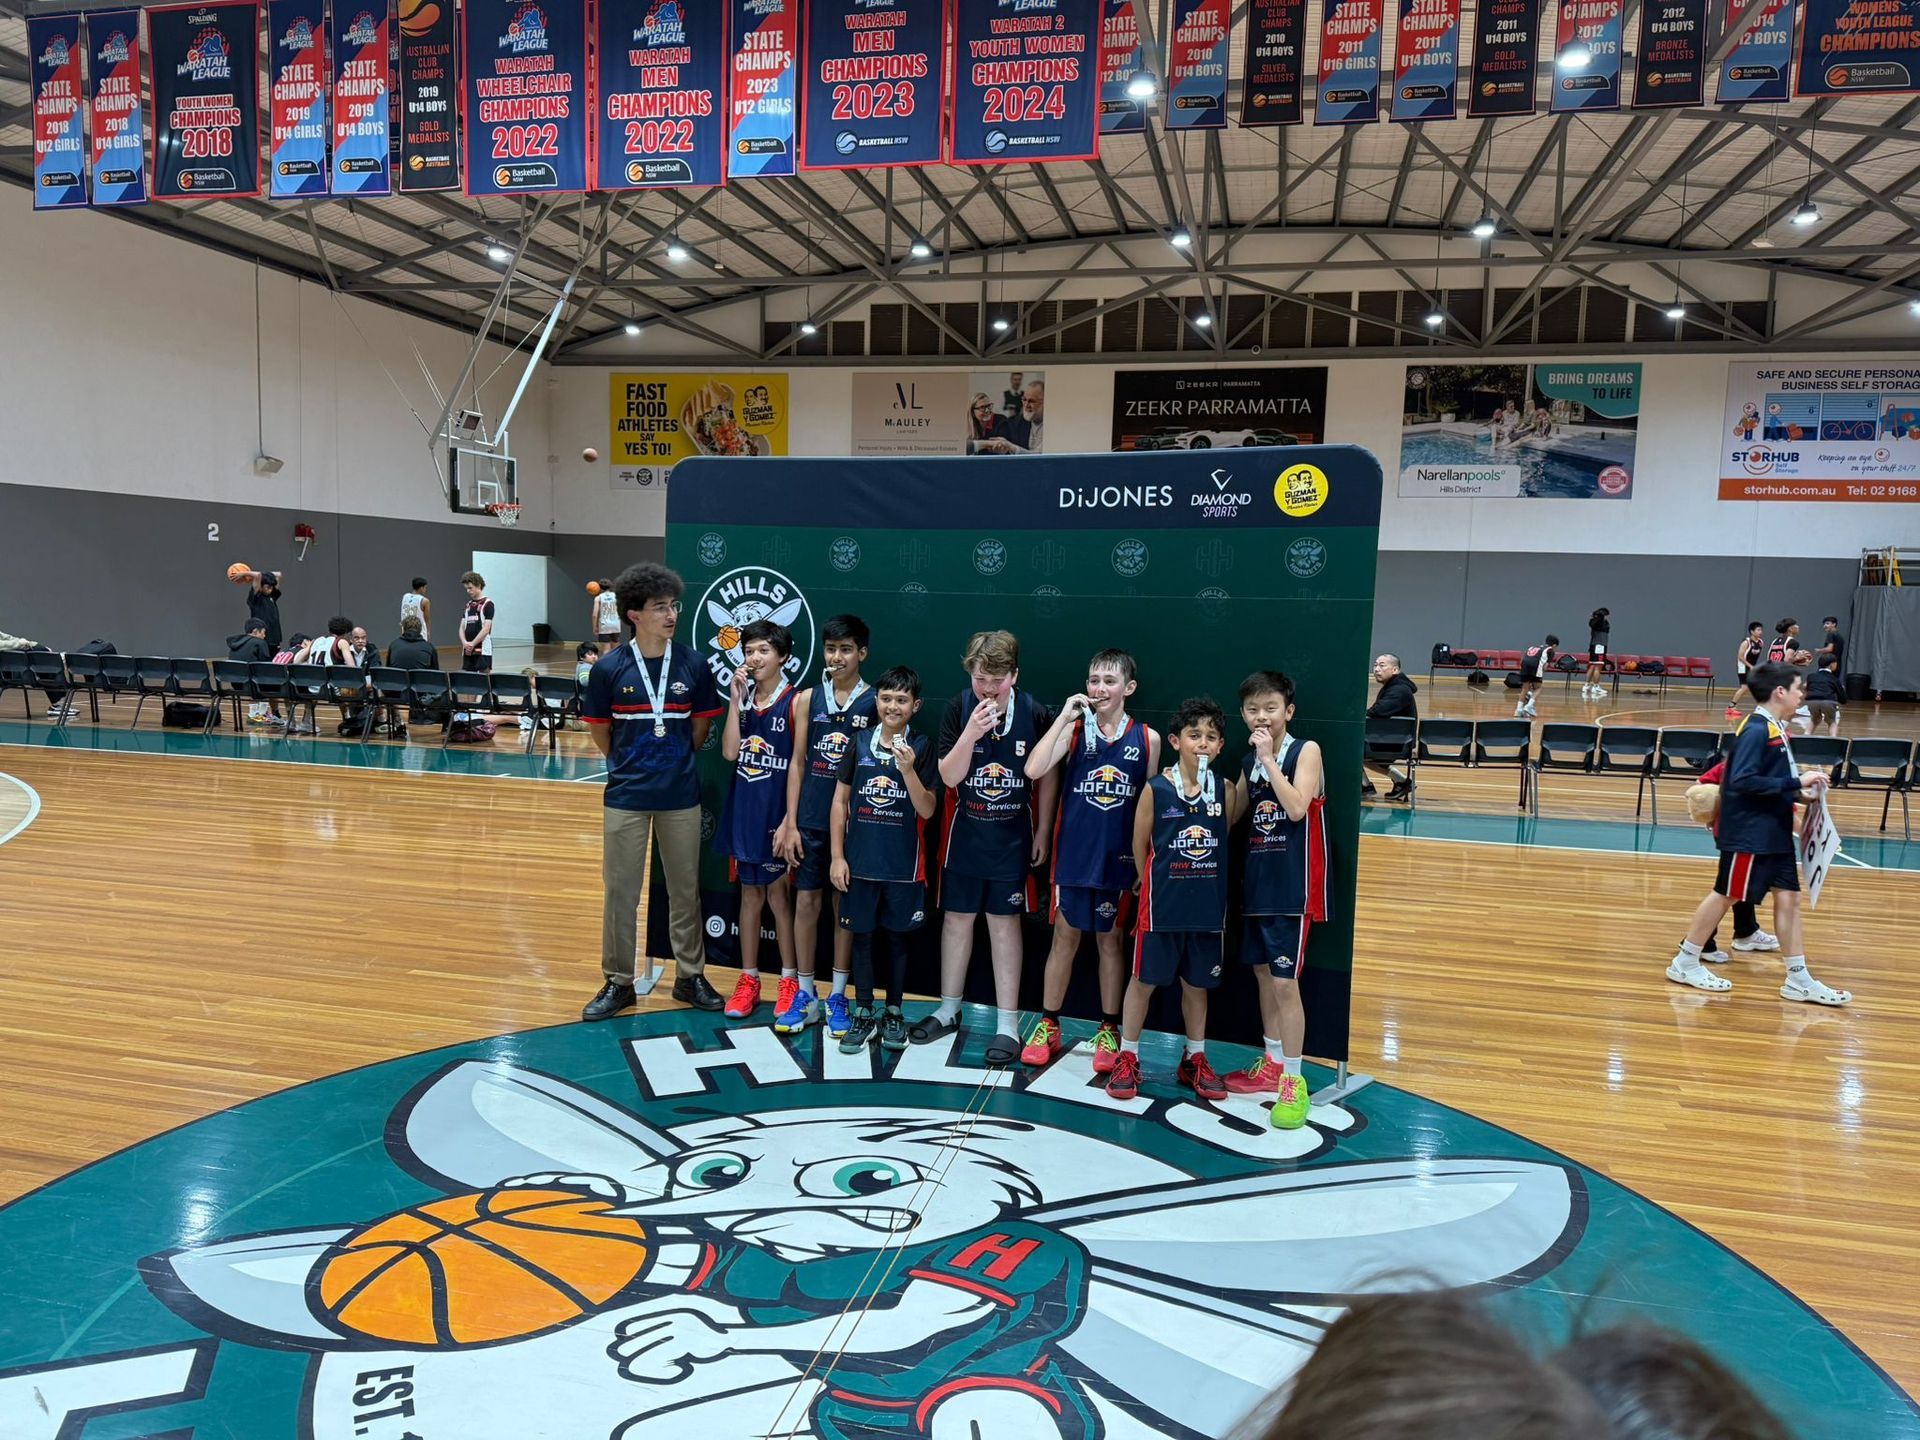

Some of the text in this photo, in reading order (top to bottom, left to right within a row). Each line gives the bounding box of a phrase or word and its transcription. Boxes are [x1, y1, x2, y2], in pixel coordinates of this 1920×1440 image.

[1335, 1, 1370, 19] STATE
[1563, 1, 1618, 20] CHAMPS
[1662, 7, 1685, 19] 2012
[188, 14, 217, 24] SPALDING
[844, 11, 906, 30] WARATAH
[990, 15, 1065, 34] WARATAH 2
[1104, 16, 1136, 32] STATE
[1184, 10, 1218, 26] STATE
[1403, 13, 1454, 31] CHAMPS
[1496, 20, 1518, 30] 2011
[1835, 14, 1913, 30] YOUTH LEAGUE
[633, 22, 683, 41] WARATAH
[1177, 26, 1225, 43] CHAMPS
[1327, 18, 1378, 36] CHAMPS
[1651, 21, 1694, 33] U14 BOYS
[499, 28, 546, 48] WARATAH
[648, 32, 685, 46] LEAGUE
[744, 30, 783, 51] STATE
[852, 29, 894, 53] MEN
[1265, 34, 1286, 44] 2010
[1415, 36, 1441, 49] 2011
[1485, 32, 1527, 45] U14 BOYS
[1656, 39, 1688, 49] BRONZE
[1754, 31, 1786, 45] BOYS
[1820, 31, 1920, 53] CHAMPIONS
[512, 39, 549, 53] LEAGUE
[969, 34, 1085, 58] YOUTH WOMEN
[1272, 46, 1294, 56] BOYS
[1338, 40, 1363, 54] 2011
[628, 46, 691, 66] WARATAH
[736, 50, 791, 72] CHAMPS
[1107, 53, 1132, 66] 2010
[1187, 48, 1212, 61] 2010
[1401, 52, 1452, 67] U14 BOYS
[1648, 50, 1695, 61] MEDALISTS
[343, 60, 377, 78] STATE
[495, 54, 554, 74] WARATAH
[821, 53, 928, 84] CHAMPIONS
[1175, 64, 1223, 78] U14 BOYS
[1261, 63, 1286, 74] SILVER
[1323, 56, 1376, 71] U16 GIRLS
[1482, 61, 1528, 72] MEDALISTS
[281, 64, 314, 82] STATE
[412, 69, 444, 80] CHAMPS
[641, 66, 679, 89] MEN
[972, 57, 1079, 86] CHAMPIONS
[1850, 66, 1895, 77] Basketball
[42, 80, 72, 96] STATE
[100, 76, 130, 94] STATE
[274, 82, 321, 101] CHAMPS
[337, 78, 385, 97] CHAMPS
[418, 86, 439, 98] 2019
[476, 73, 572, 98] WHEELCHAIR
[746, 77, 778, 94] 2023
[37, 97, 78, 115] CHAMPS
[95, 94, 138, 112] CHAMPS
[176, 94, 233, 110] YOUTH WOMEN
[426, 100, 447, 112] BOYS
[608, 89, 712, 120] CHAMPIONS
[735, 98, 792, 115] U12 GIRLS
[831, 80, 915, 121] 2023
[982, 84, 1066, 123] 2024
[286, 106, 310, 121] 2019
[348, 103, 374, 117] 2019
[480, 95, 569, 123] CHAMPIONS
[106, 118, 128, 132] 2018
[170, 108, 241, 128] CHAMPIONS
[46, 121, 69, 134] 2018
[275, 124, 323, 140] U14 GIRLS
[337, 121, 384, 136] U14 BOYS
[113, 134, 140, 148] GIRLS
[182, 128, 232, 157] 2018
[408, 132, 450, 144] MEDALISTS
[492, 123, 558, 158] 2022
[624, 119, 694, 154] 2022
[858, 136, 894, 146] BASKETBALL
[1009, 137, 1044, 145] BASKETBALL
[512, 168, 545, 177] Basketball
[645, 163, 680, 173] Basketball
[1549, 372, 1634, 385] BRING DREAMS
[1757, 370, 1785, 379] SAFE
[1788, 370, 1811, 378] AND
[1815, 370, 1861, 378] SECURE
[626, 384, 667, 400] FAST
[1593, 387, 1632, 399] TO LIFE
[1782, 382, 1838, 390] BUSINESS
[1840, 381, 1868, 390] SELF
[627, 402, 668, 418] FOOD
[1126, 398, 1312, 416] ZEEKR PARRAMATTA
[618, 419, 678, 432] ATHLETES
[640, 433, 655, 442] SAY
[625, 443, 671, 455] YES TO!
[1732, 451, 1800, 462] STORHUB
[1817, 453, 1845, 464] Keeping
[1859, 455, 1872, 463] eye
[1417, 469, 1500, 483] Narellanpools
[1862, 465, 1878, 474] your
[1880, 464, 1896, 472] stuff
[1897, 464, 1916, 472] 24/7
[1285, 488, 1316, 498] GUZMAN
[1440, 485, 1481, 493] Hills District
[1744, 486, 1916, 496] storhub.com.au Tel: 02 9168
[1059, 486, 1173, 508] DiJONES
[1191, 493, 1251, 506] DIAMOND
[1292, 495, 1318, 504] GOMEZ
[1203, 506, 1238, 517] SPORTS
[208, 524, 219, 541] 2
[1294, 539, 1317, 549] HILLS
[1289, 562, 1322, 576] HORNETS
[719, 575, 787, 604] HILLS
[770, 717, 785, 732] 13
[852, 715, 868, 728] 35
[1015, 741, 1026, 756] 5
[1124, 746, 1140, 761] 22
[965, 777, 1024, 788] JOFLOW
[859, 786, 907, 799] JOFLOW
[873, 808, 903, 817] Services
[987, 802, 1021, 811] Services
[1206, 802, 1222, 817] 99
[1168, 838, 1218, 848] JOFLOW
[629, 1022, 1360, 1160] HILLS
[946, 1232, 1042, 1282] H
[352, 1364, 415, 1436] EST.
